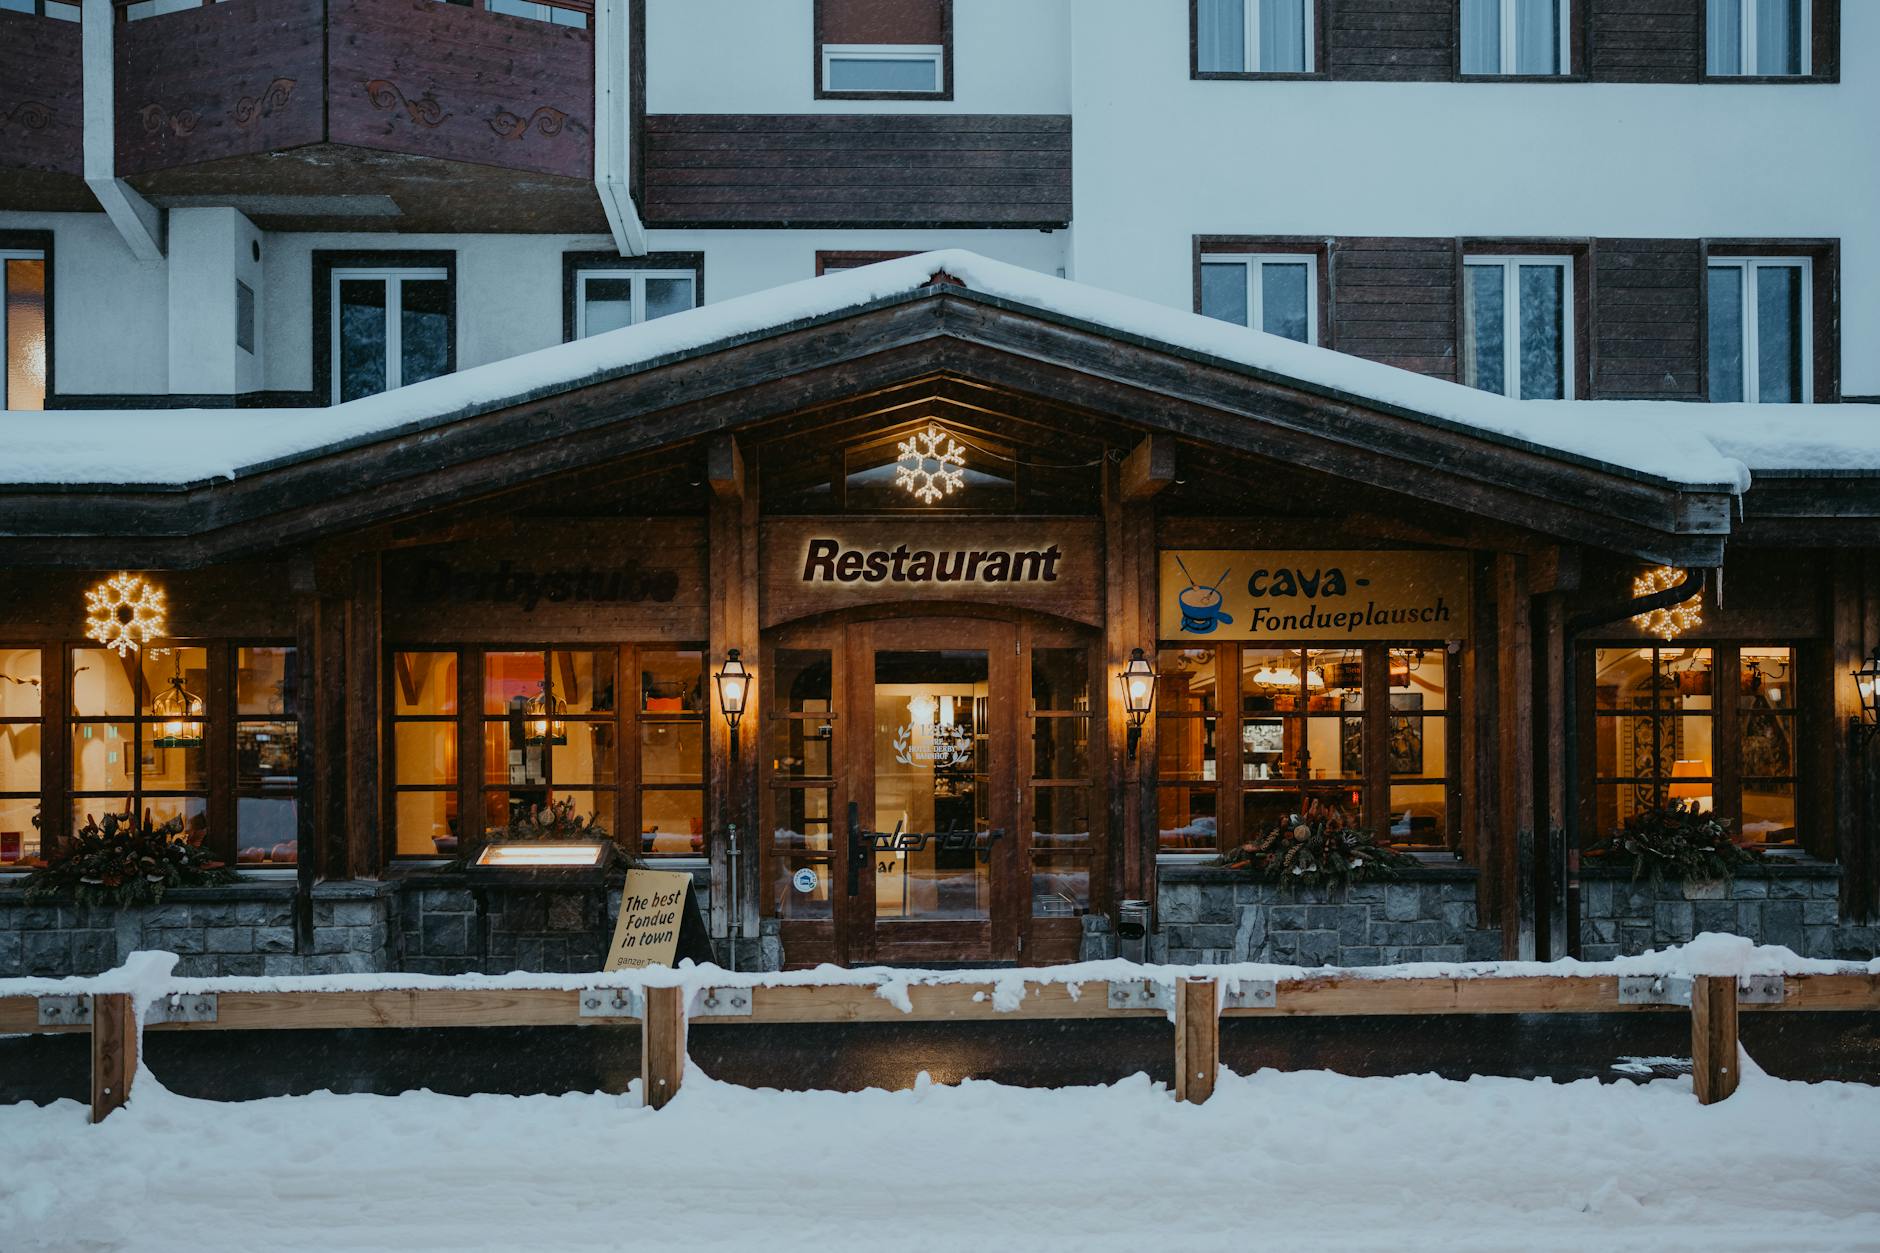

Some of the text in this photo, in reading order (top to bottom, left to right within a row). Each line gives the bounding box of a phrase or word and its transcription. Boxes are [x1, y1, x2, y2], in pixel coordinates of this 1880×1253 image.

[802, 538, 1062, 582] Restaurant
[1249, 597, 1450, 632] Fondueplausch
[877, 861, 896, 873] ar
[626, 889, 681, 912] The best
[626, 910, 675, 930] Fondue
[621, 930, 673, 948] in town
